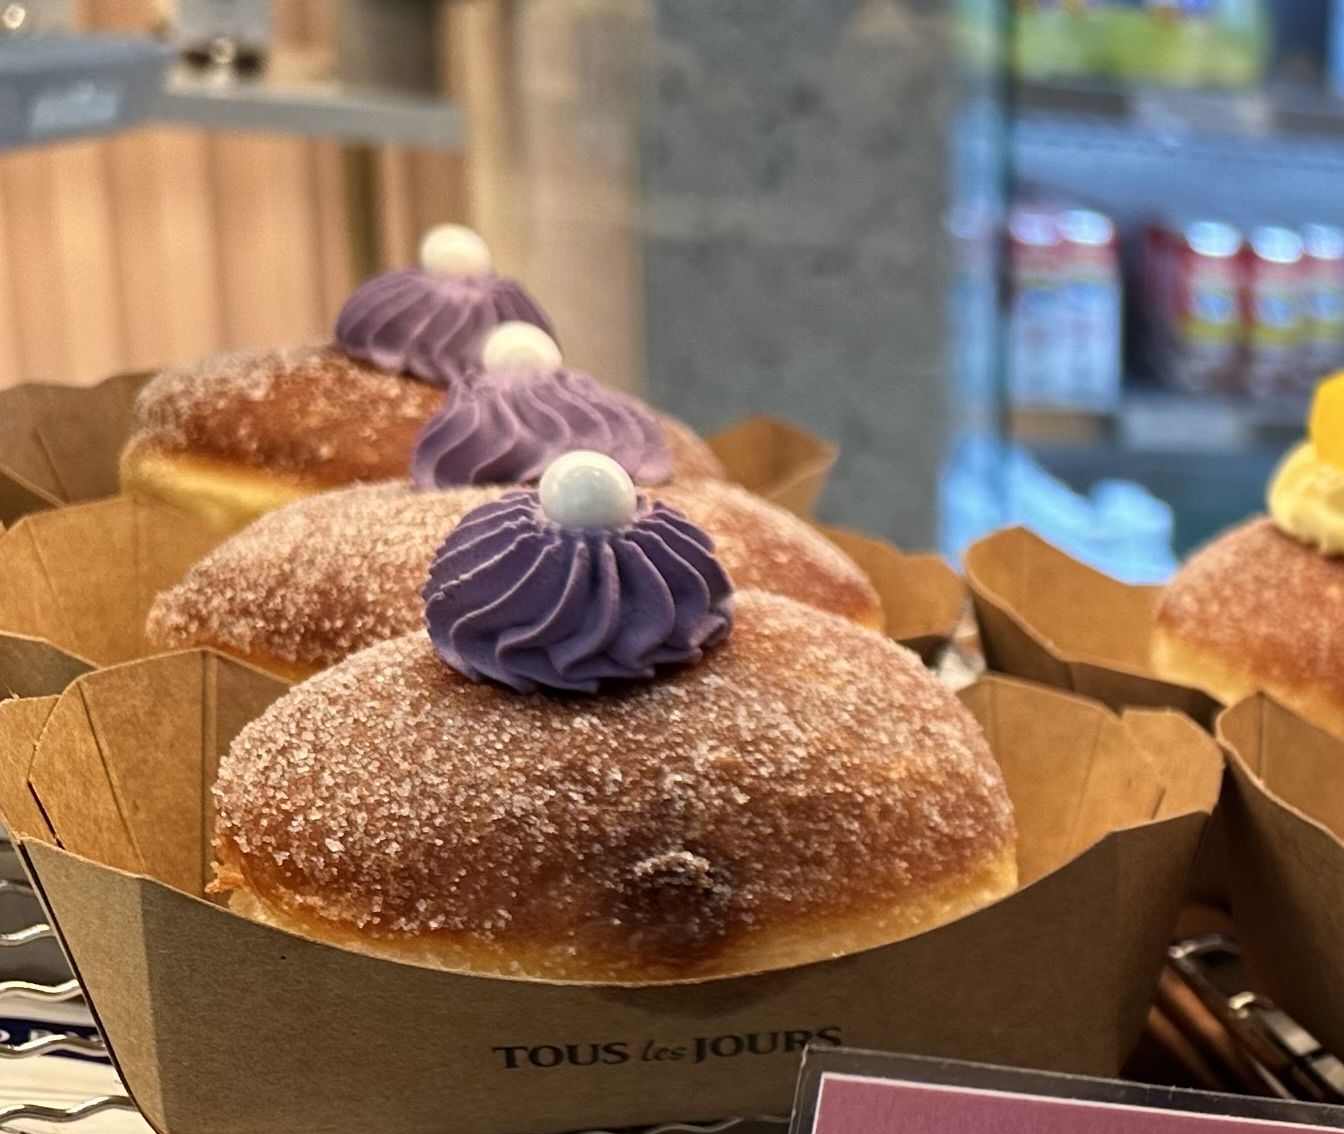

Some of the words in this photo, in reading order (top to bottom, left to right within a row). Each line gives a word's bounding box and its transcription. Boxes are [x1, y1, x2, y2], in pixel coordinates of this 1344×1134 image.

[493, 1041, 630, 1069] TOUS
[641, 1038, 686, 1062] les
[693, 1026, 842, 1064] JOURS
